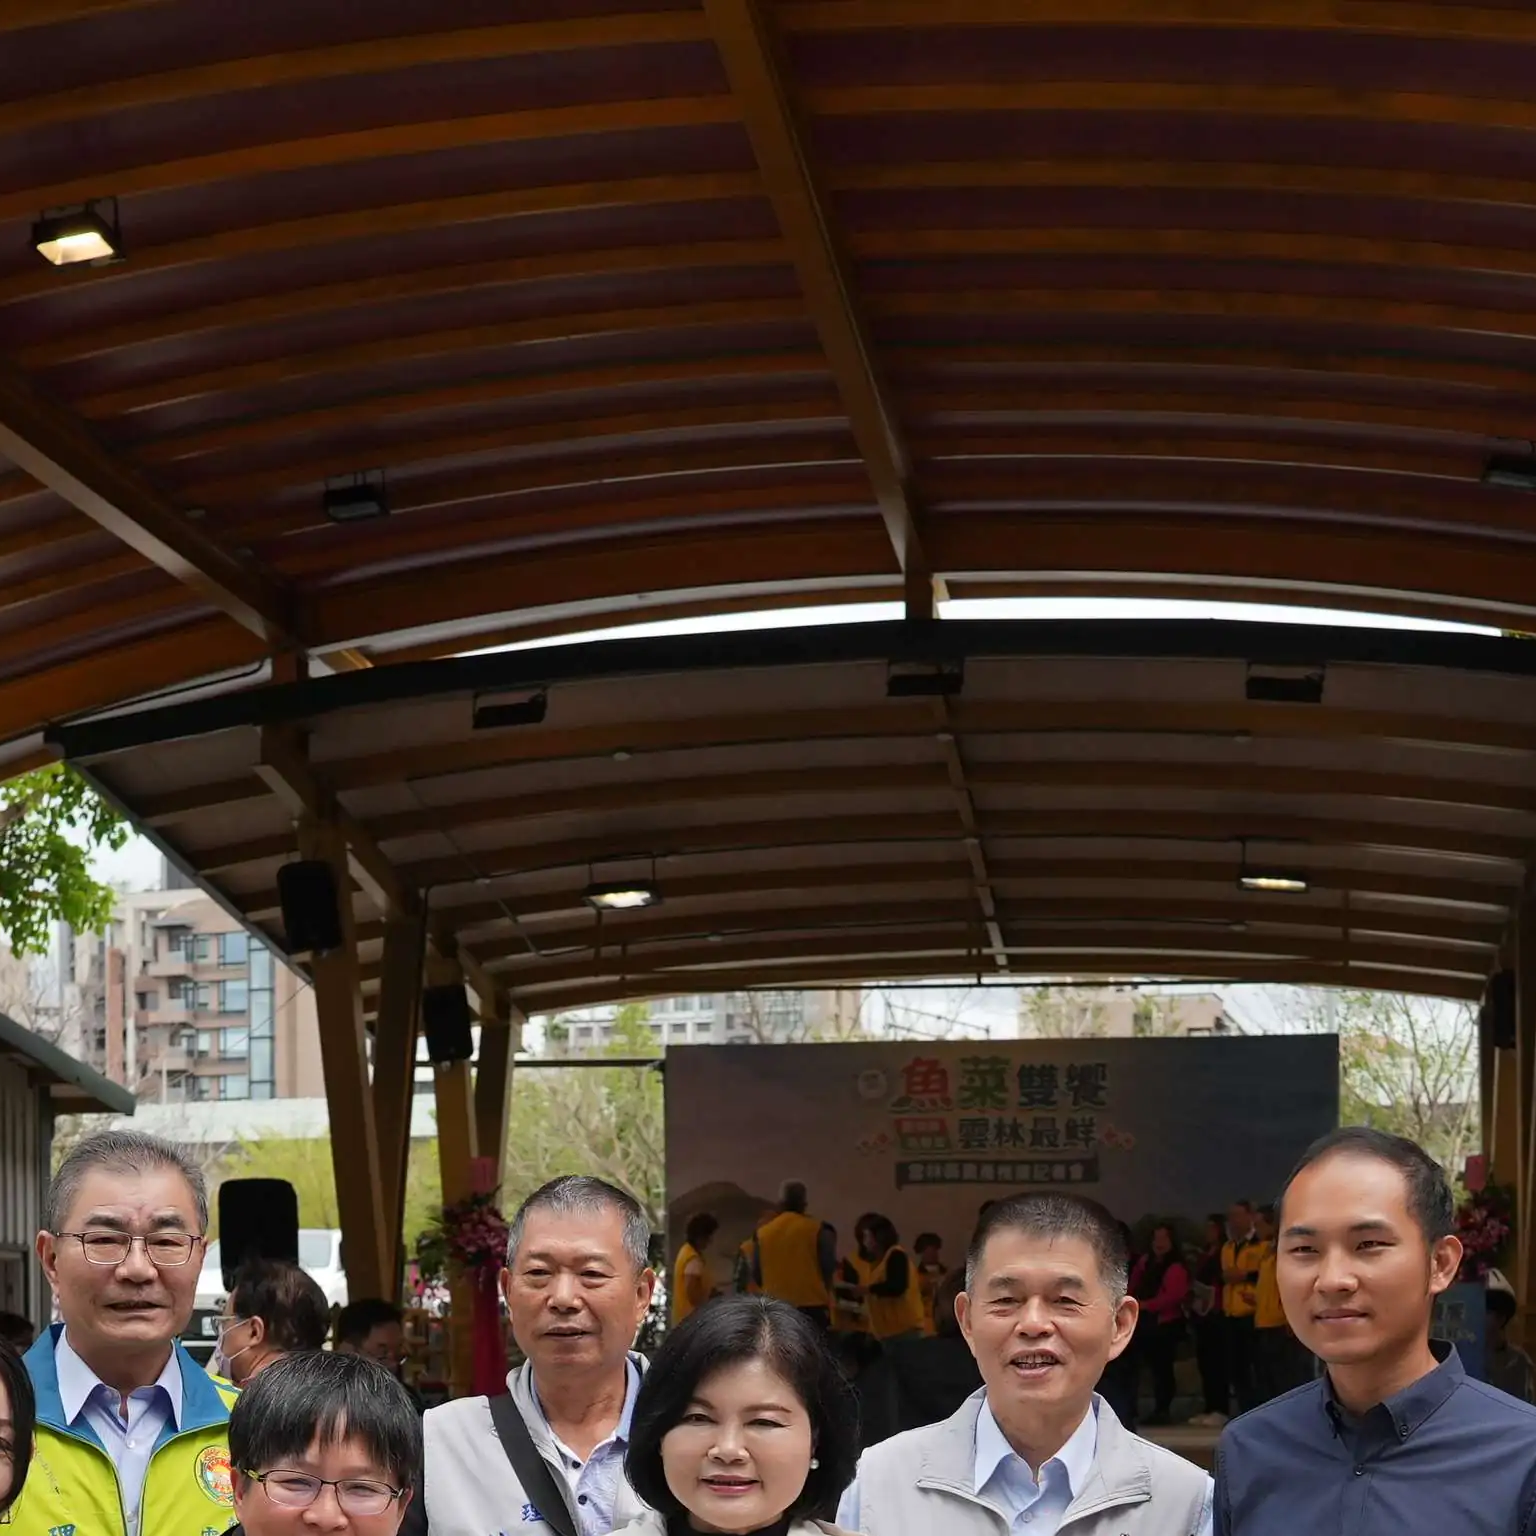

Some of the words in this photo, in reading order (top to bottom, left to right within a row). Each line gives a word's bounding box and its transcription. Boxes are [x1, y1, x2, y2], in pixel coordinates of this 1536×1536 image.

[889, 1055, 1108, 1112] 魚菜雙饗
[958, 1117, 1096, 1149] 雲林最鮮
